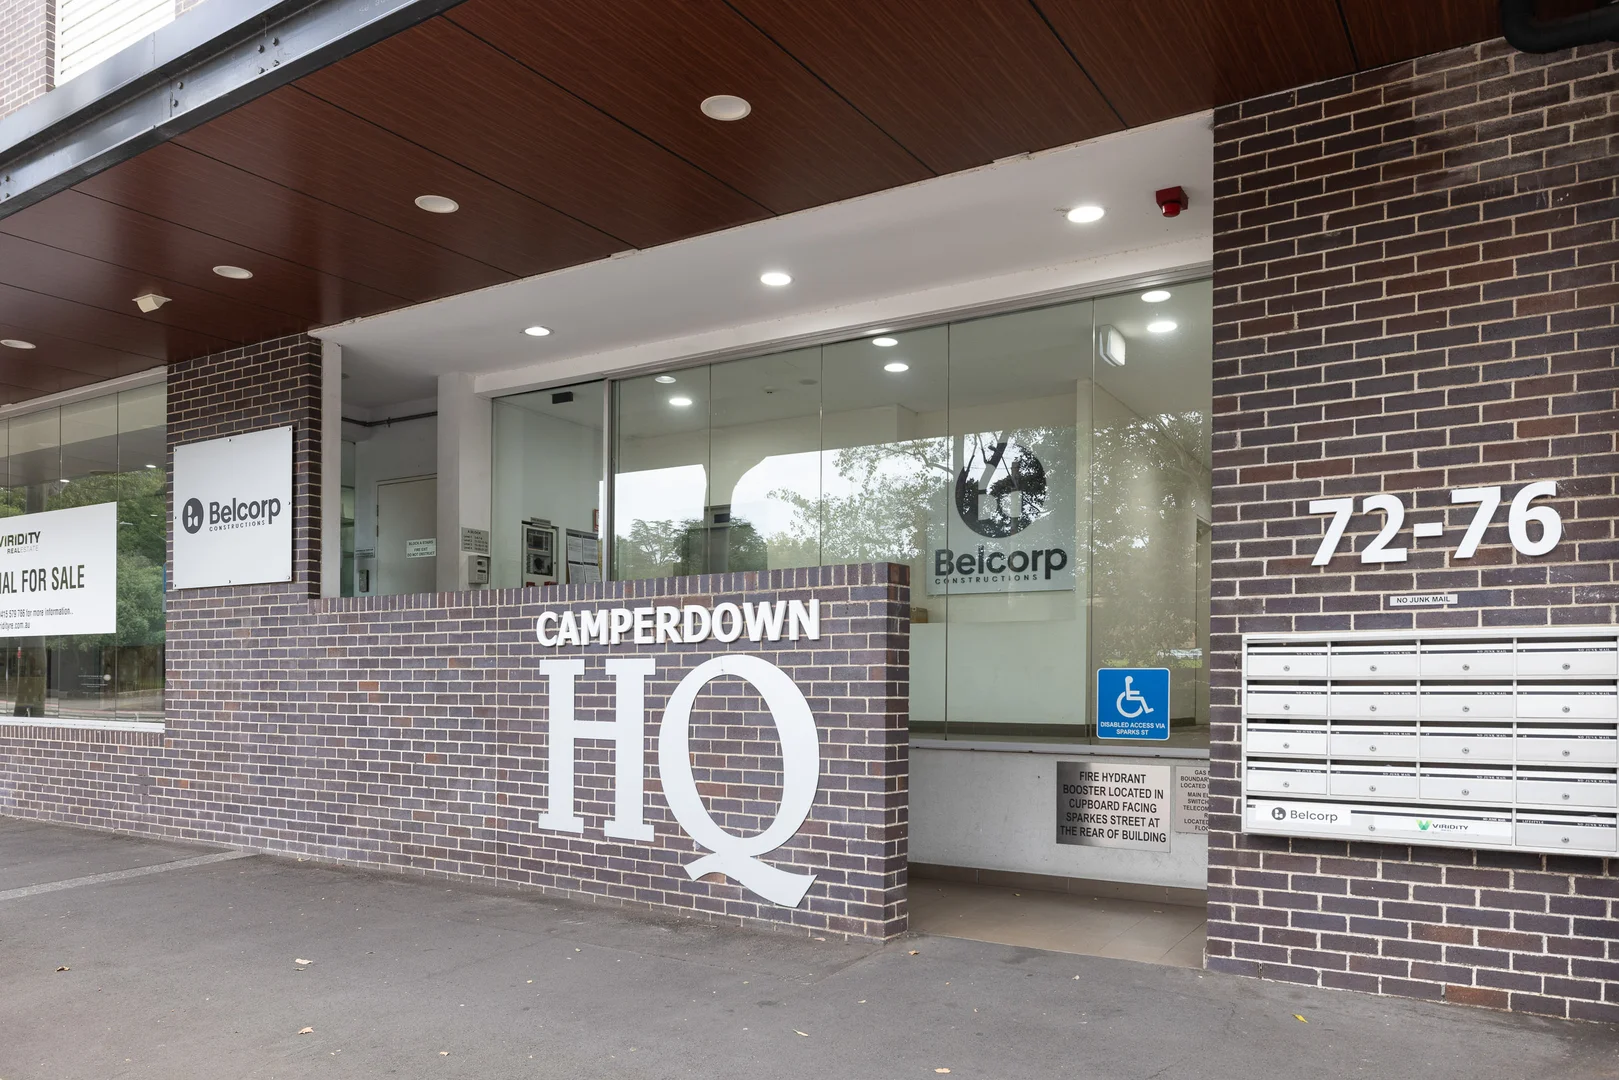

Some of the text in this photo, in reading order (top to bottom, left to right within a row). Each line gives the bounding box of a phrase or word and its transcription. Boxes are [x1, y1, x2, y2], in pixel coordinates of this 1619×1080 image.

[209, 497, 281, 525] Belcorp
[209, 519, 266, 532] CONSTRUCTIONS
[1309, 480, 1562, 566] 72-76
[935, 545, 1068, 580] Belcorp
[22, 568, 47, 593] FOR
[51, 564, 85, 591] SALE
[935, 574, 1038, 585] CONSTRUCTIONS
[536, 598, 821, 647] CAMPERDOWN
[538, 654, 819, 908] HQ
[1079, 771, 1146, 784] FIRE HYDRANT
[1062, 784, 1164, 799] BOOSTER LOCATED IN
[1069, 798, 1157, 814] CUPBOARD FACING
[1066, 812, 1160, 828] SPARKES STREET AT
[1290, 810, 1338, 824] Belcorp
[1060, 826, 1167, 843] THE REAR OF BUILDING
